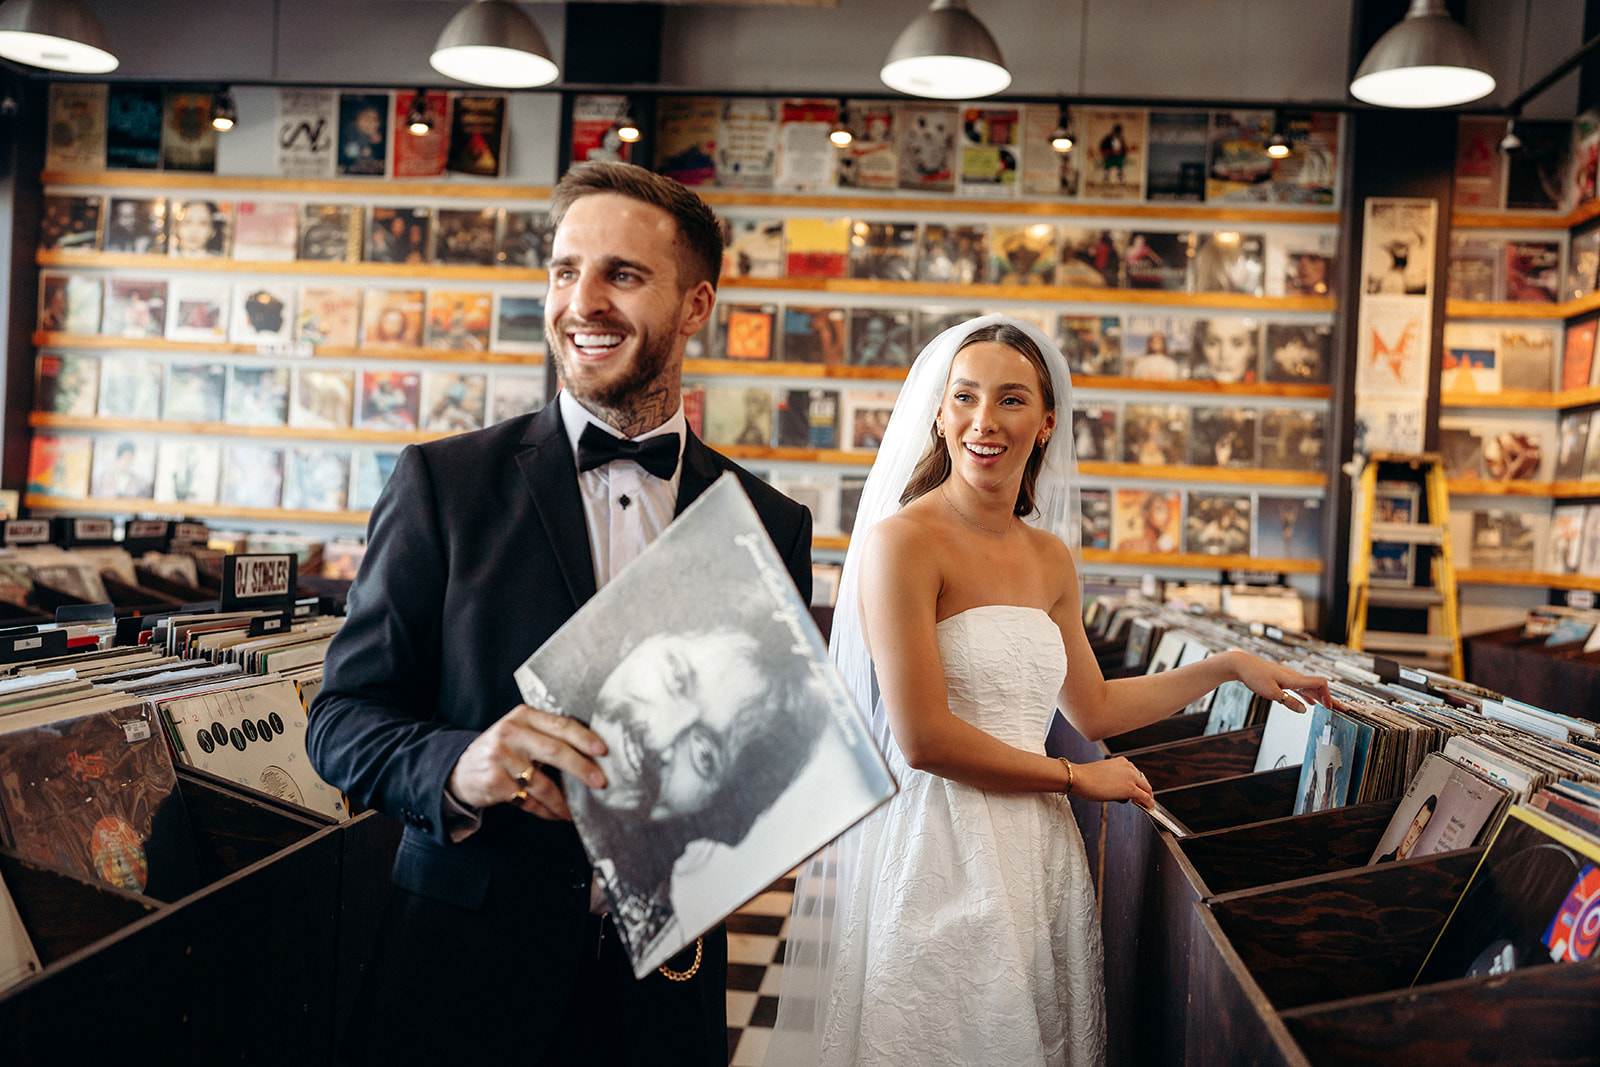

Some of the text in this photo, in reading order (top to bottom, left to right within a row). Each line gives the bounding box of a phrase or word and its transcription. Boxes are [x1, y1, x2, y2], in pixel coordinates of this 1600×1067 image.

[237, 560, 287, 595] DJ SINGLES
[199, 713, 283, 752] SINGLE
